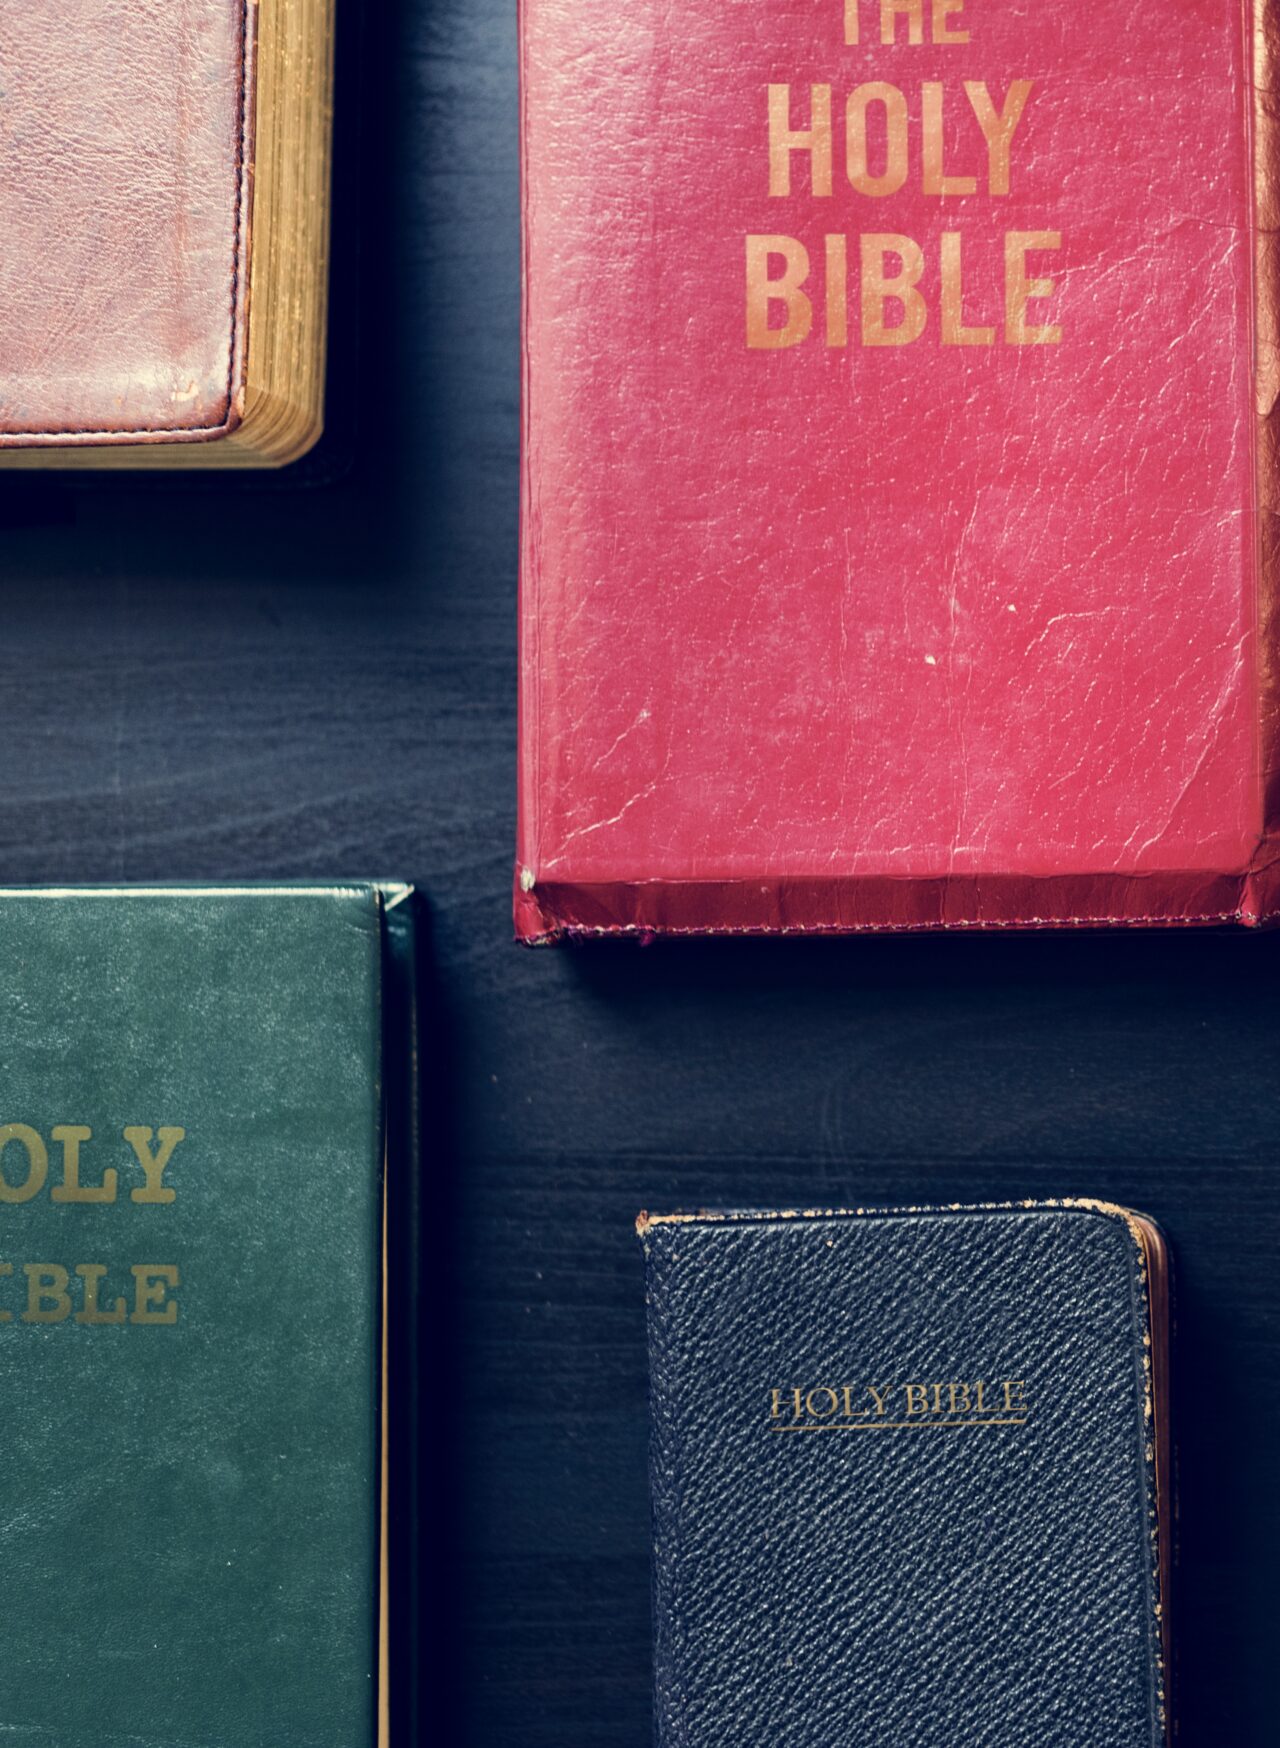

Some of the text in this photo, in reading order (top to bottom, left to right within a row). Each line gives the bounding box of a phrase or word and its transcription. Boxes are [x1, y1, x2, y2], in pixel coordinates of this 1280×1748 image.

[768, 80, 1034, 197] HOLY
[745, 231, 1063, 349] BIBLE
[0, 1263, 180, 1324] BLE
[769, 1380, 1027, 1419] HOLY BIBLE
